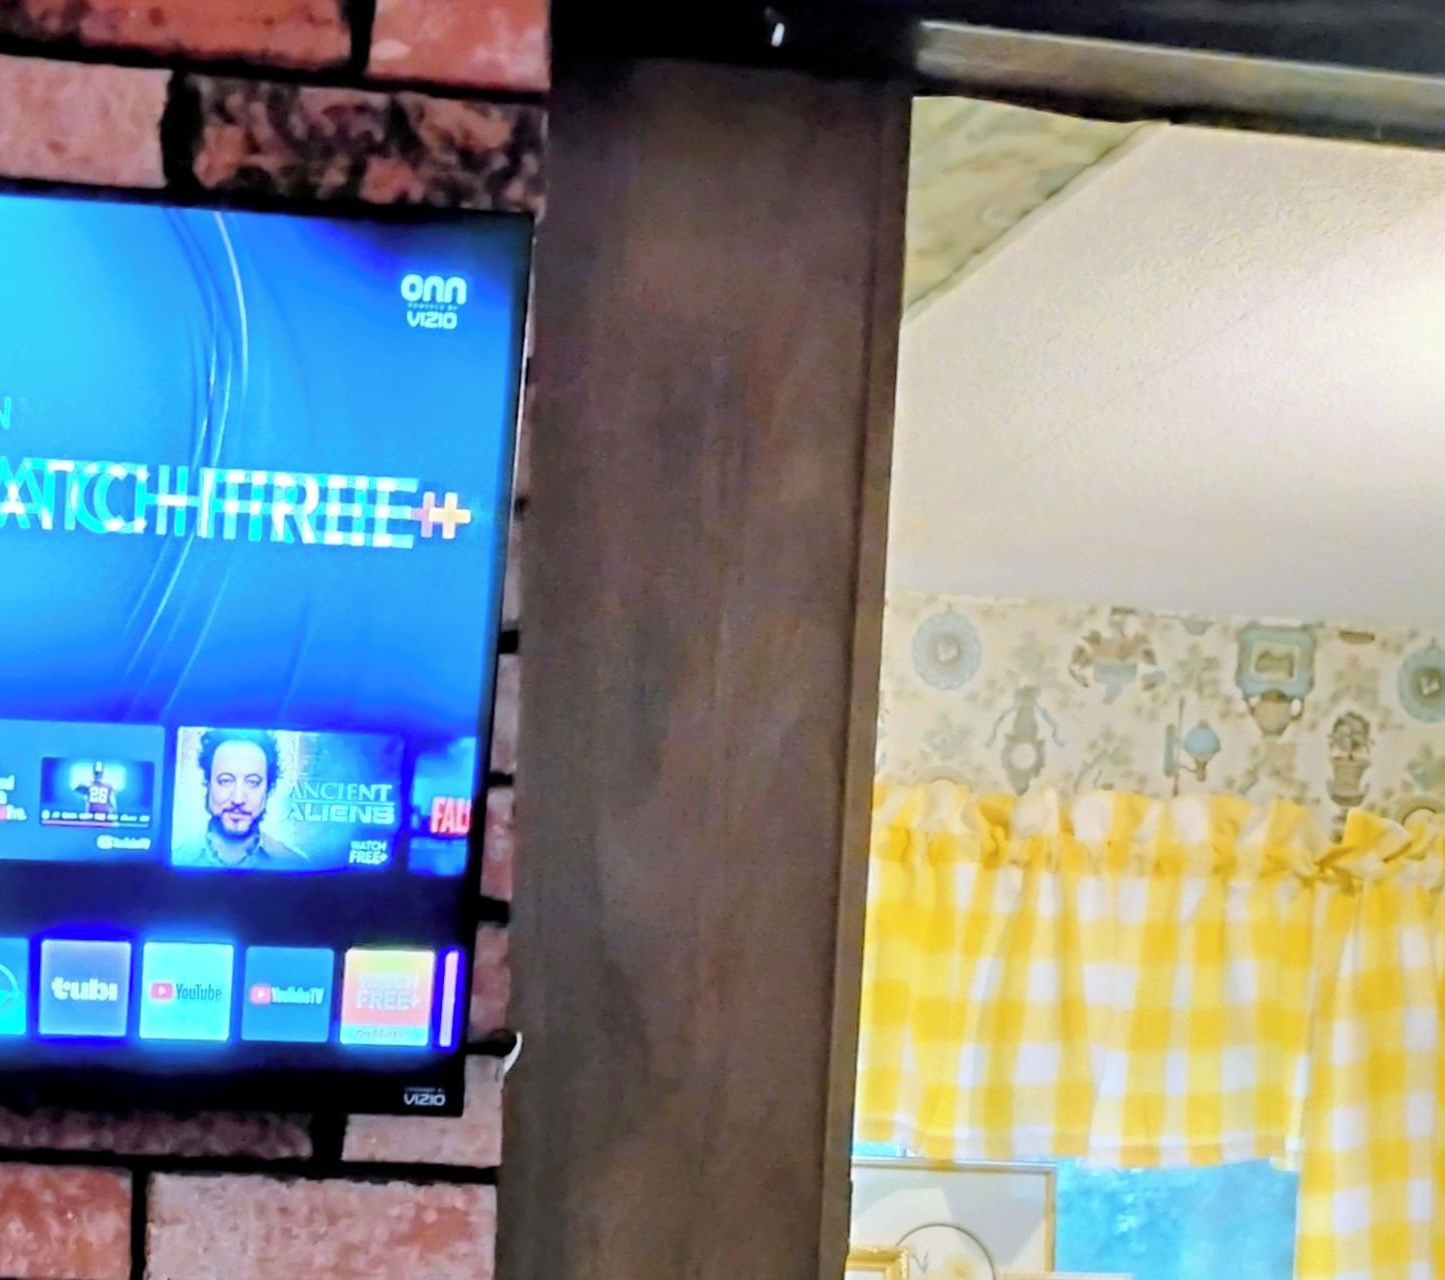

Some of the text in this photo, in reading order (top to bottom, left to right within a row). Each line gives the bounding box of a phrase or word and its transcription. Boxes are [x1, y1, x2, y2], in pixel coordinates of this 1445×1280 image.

[401, 274, 467, 304] onn
[407, 310, 458, 329] VIZIO
[289, 781, 393, 802] ANCIENT
[287, 802, 395, 825] ALIENS
[51, 976, 118, 1001] tubi
[176, 983, 222, 1002] YouTube
[356, 988, 422, 1010] FREE+
[403, 1093, 447, 1107] VIZIO
